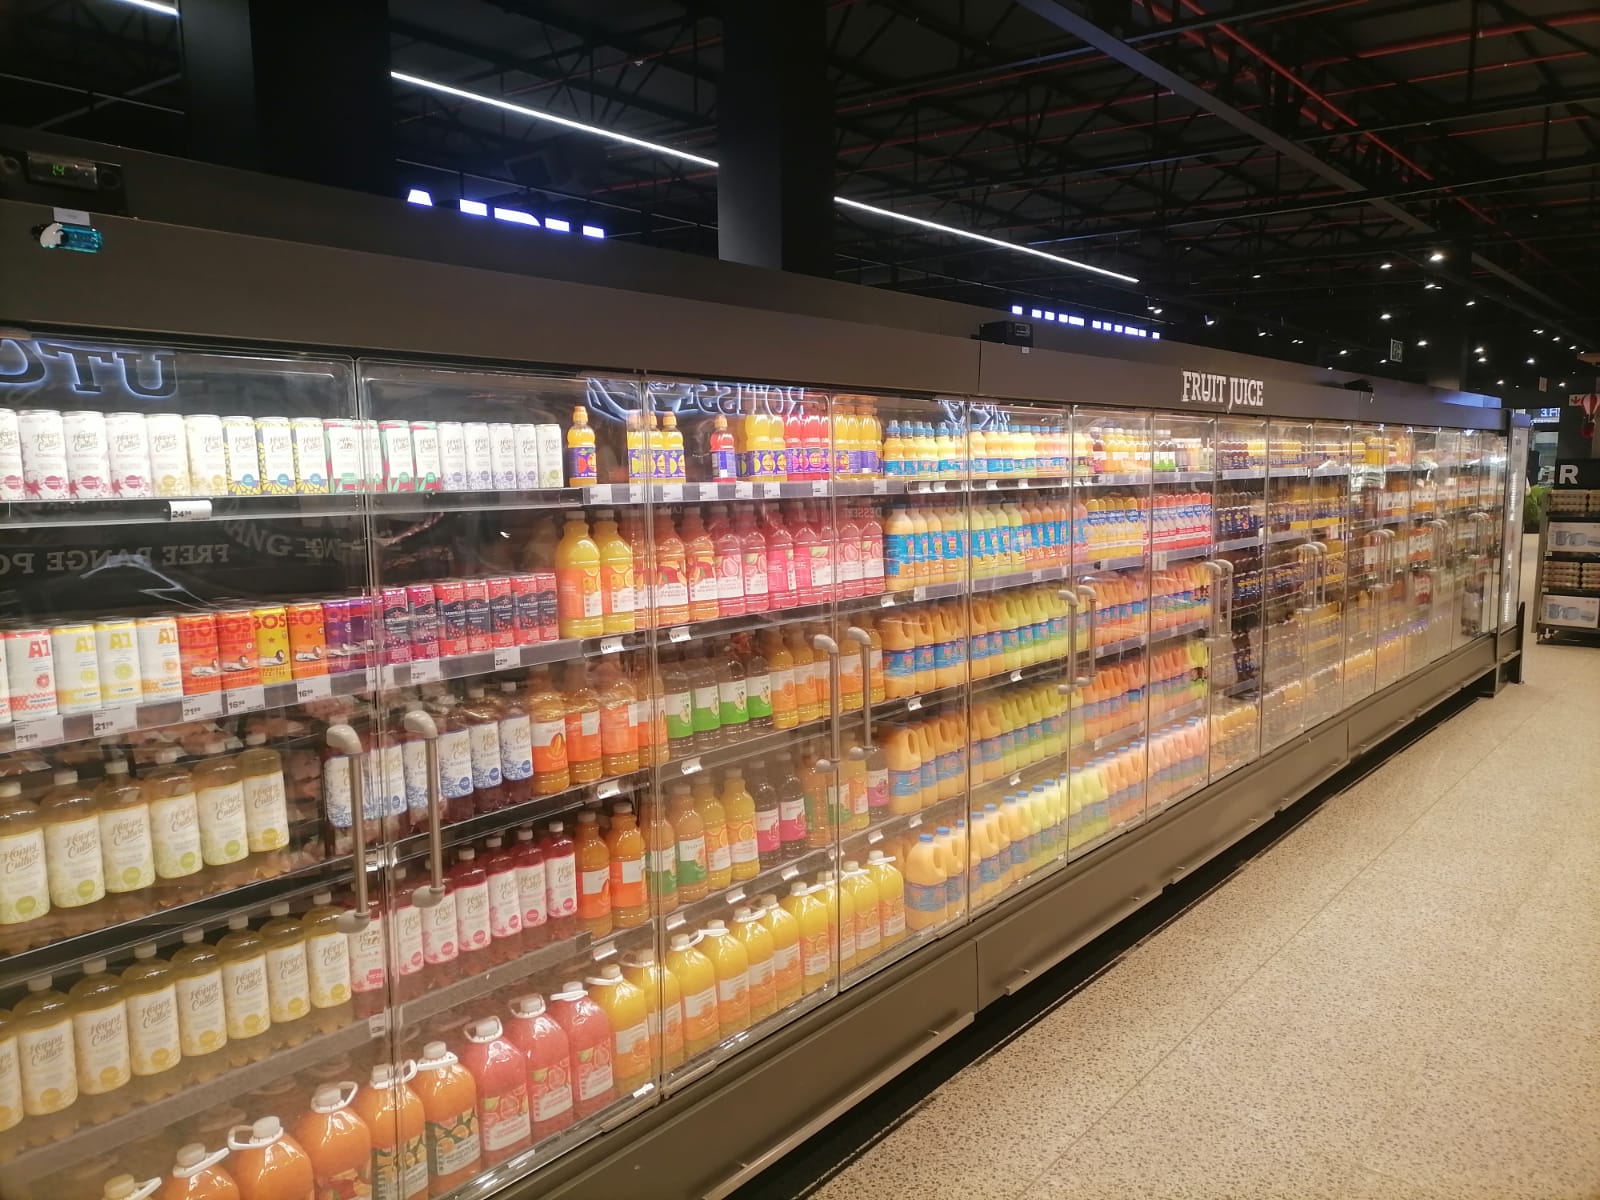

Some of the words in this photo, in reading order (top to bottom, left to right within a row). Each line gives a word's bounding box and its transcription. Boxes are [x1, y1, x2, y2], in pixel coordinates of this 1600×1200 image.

[1182, 370, 1226, 403] FRUIT
[1227, 376, 1264, 414] JUICE
[1559, 464, 1578, 484] R
[159, 628, 177, 644] A1
[184, 620, 217, 637] BO
[28, 640, 50, 658] A1
[76, 636, 95, 653] A1
[110, 632, 131, 649] A1
